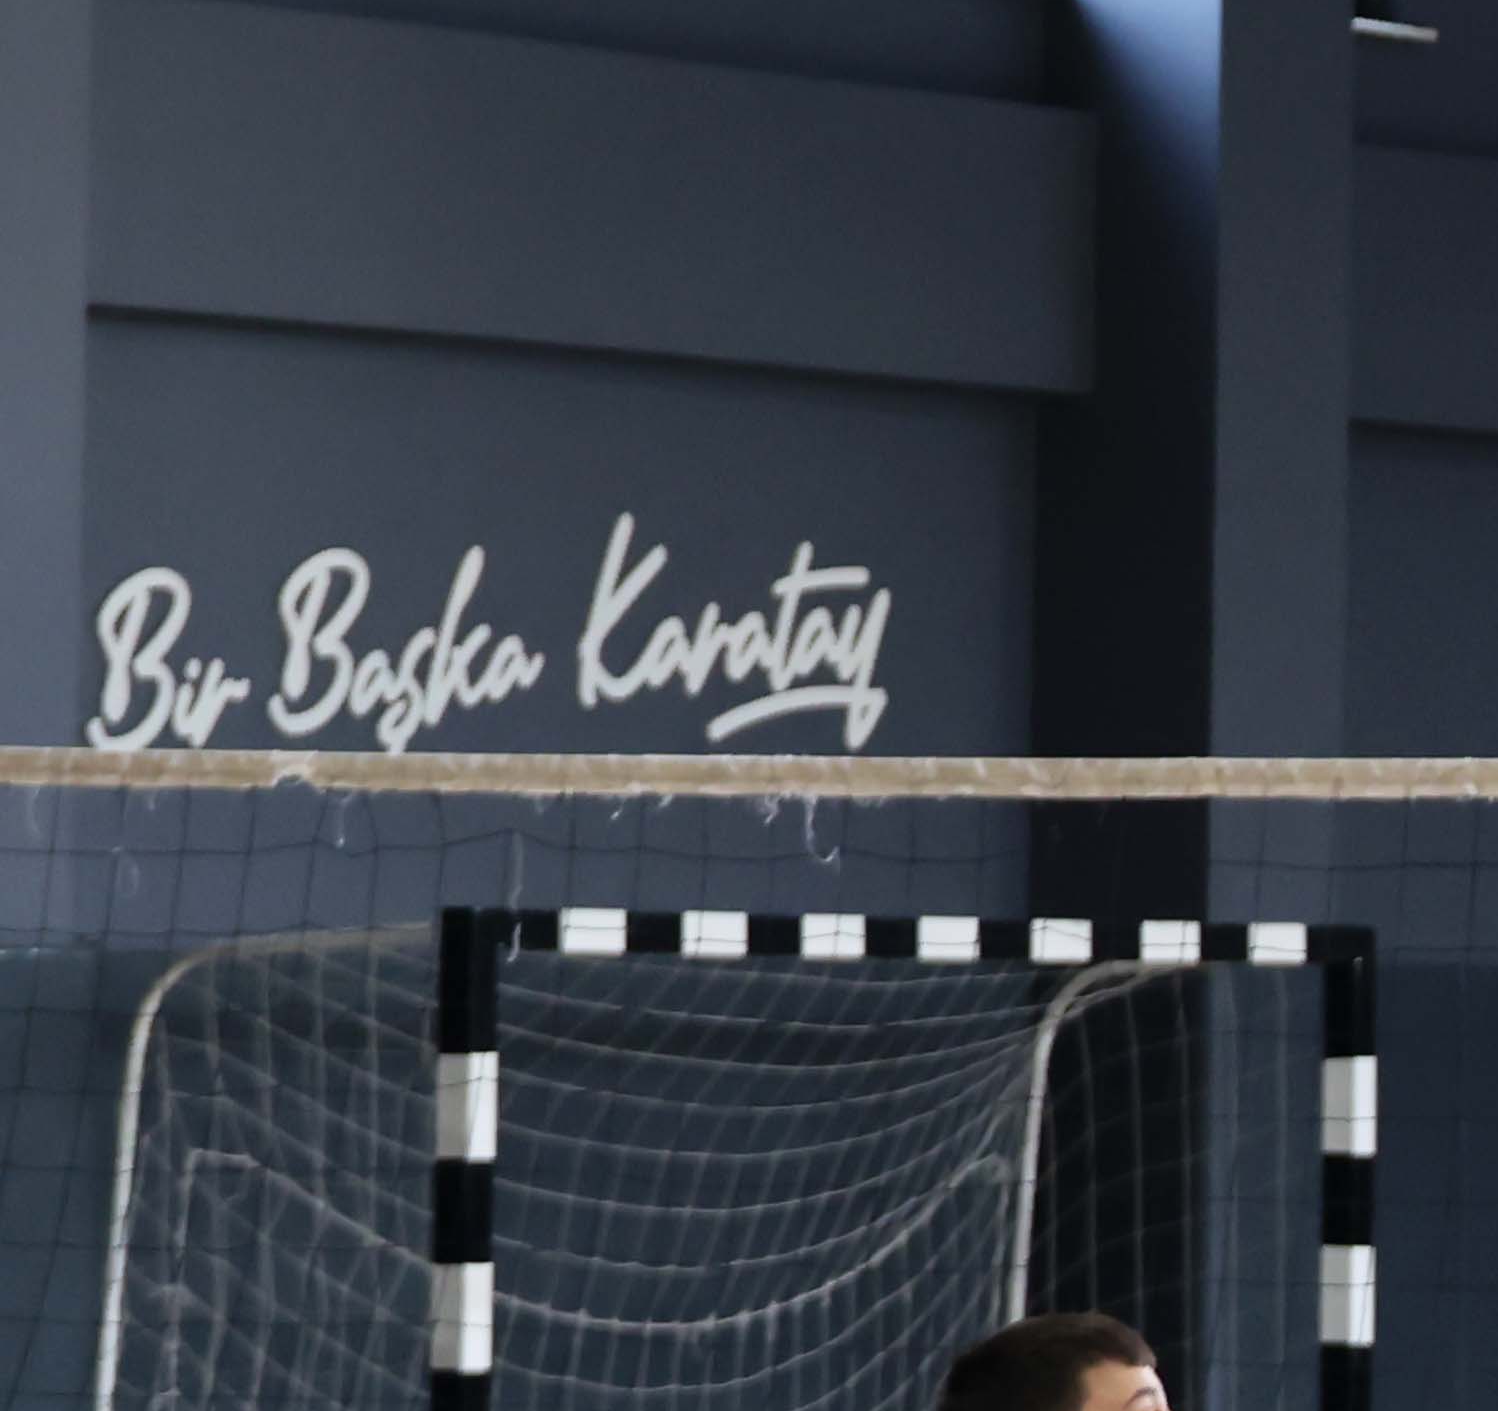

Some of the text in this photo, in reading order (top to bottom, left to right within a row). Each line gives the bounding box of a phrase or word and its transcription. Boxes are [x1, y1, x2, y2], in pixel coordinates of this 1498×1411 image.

[86, 511, 892, 754] Bir Başka Karatay
